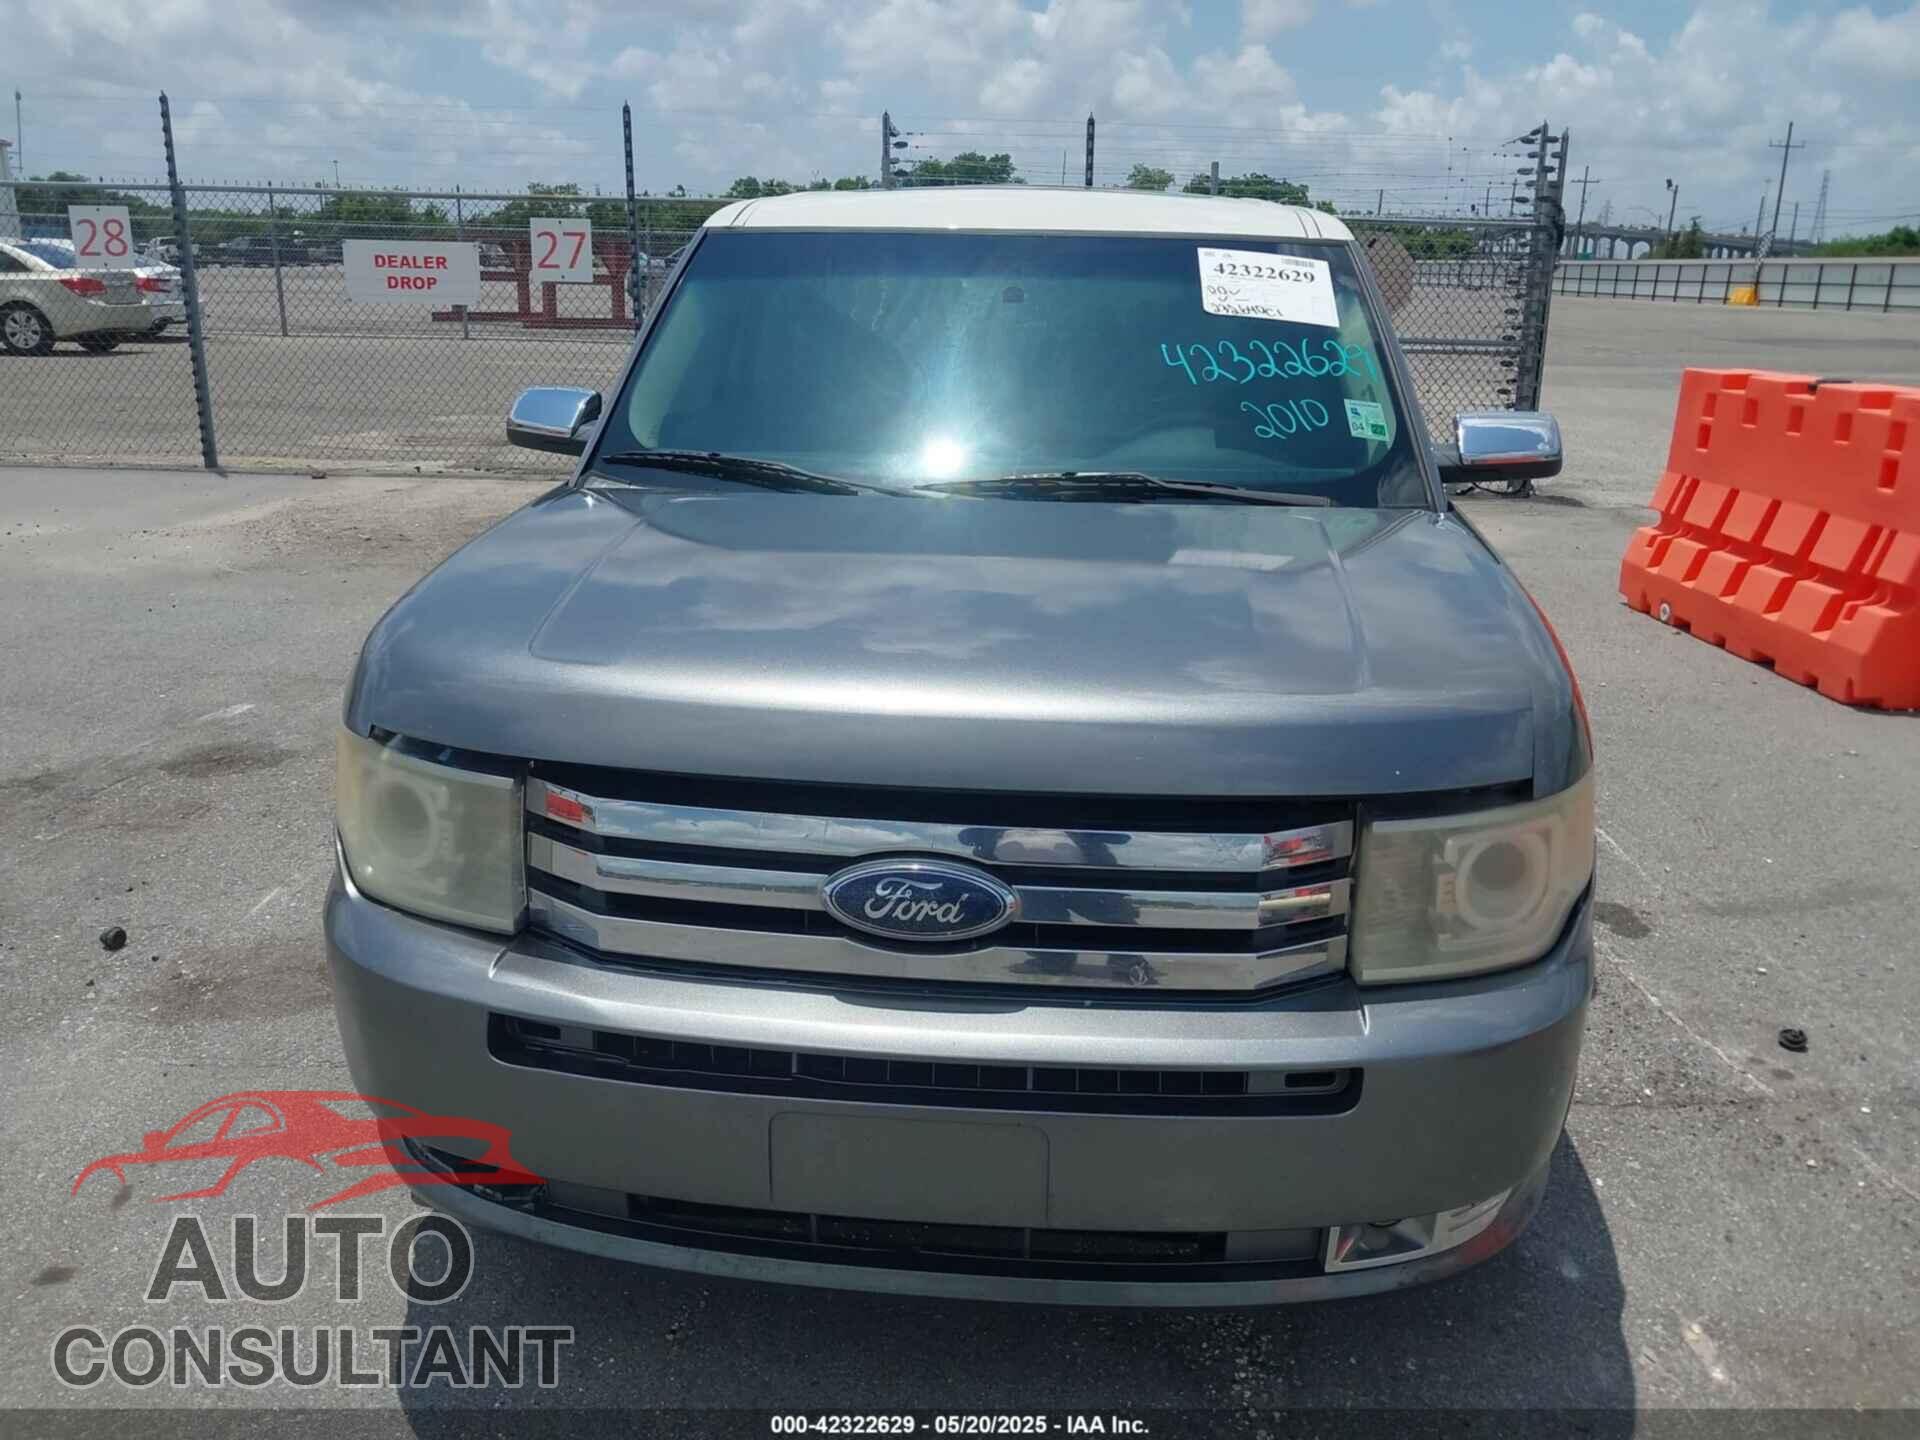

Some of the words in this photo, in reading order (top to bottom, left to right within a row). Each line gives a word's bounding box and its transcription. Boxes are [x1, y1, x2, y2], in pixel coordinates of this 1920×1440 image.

[76, 218, 128, 257] 28
[536, 231, 586, 269] 27
[374, 254, 448, 270] DEALER
[1213, 262, 1315, 284] 42322629
[386, 275, 438, 291] DROP
[1160, 338, 1377, 384] 42322629
[1240, 399, 1329, 440] 2010
[863, 877, 969, 924] Ford
